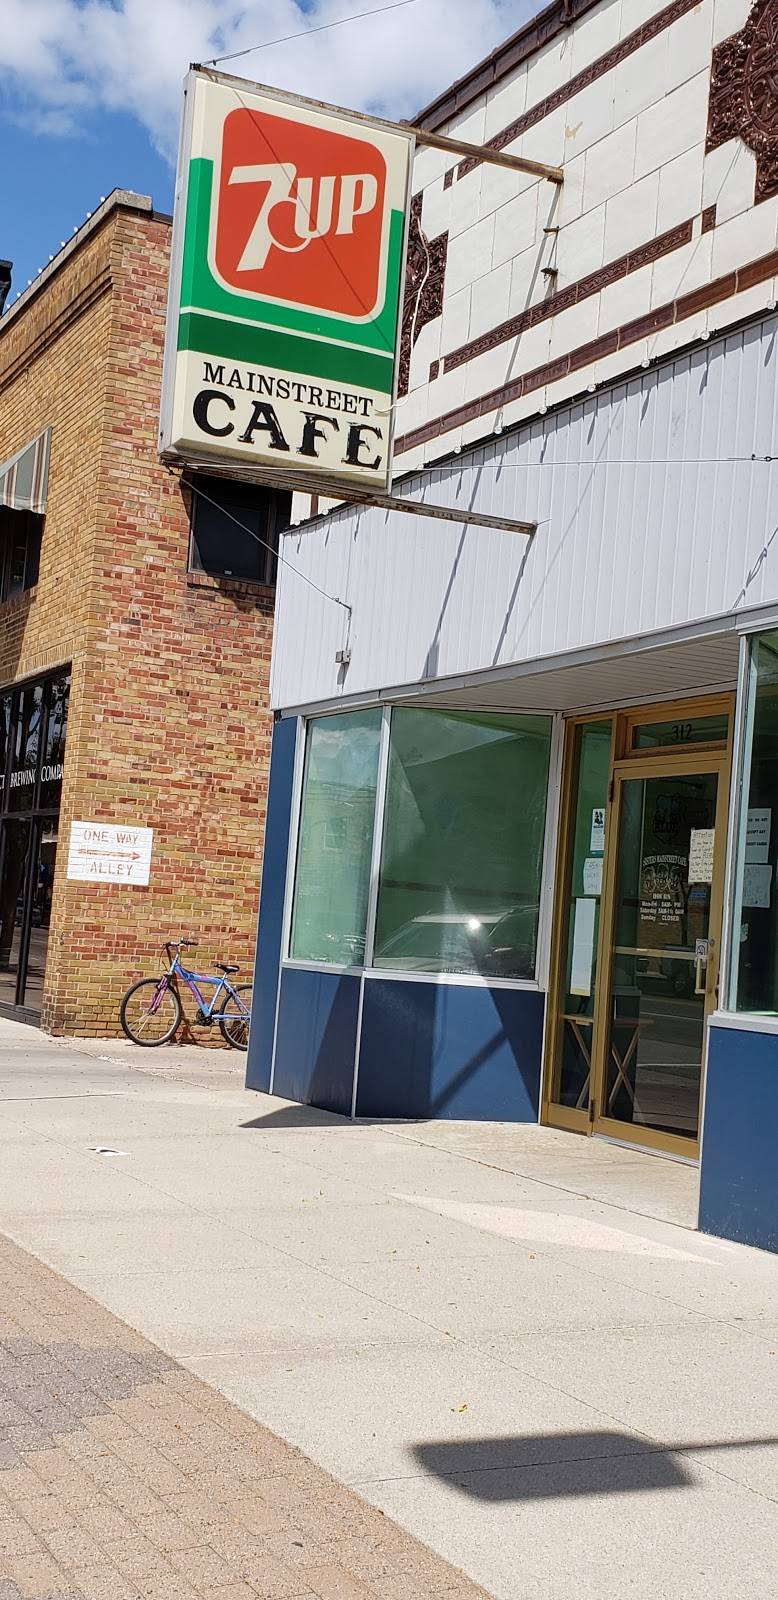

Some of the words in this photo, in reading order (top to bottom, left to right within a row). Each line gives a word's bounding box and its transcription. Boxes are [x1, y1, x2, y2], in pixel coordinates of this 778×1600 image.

[227, 162, 377, 272] 7UP
[202, 361, 373, 417] MAINSTREET
[192, 389, 384, 470] CAFE
[672, 723, 692, 741] 312
[83, 829, 109, 842] ONE
[116, 833, 139, 844] WAY
[90, 862, 133, 876] ALLEY
